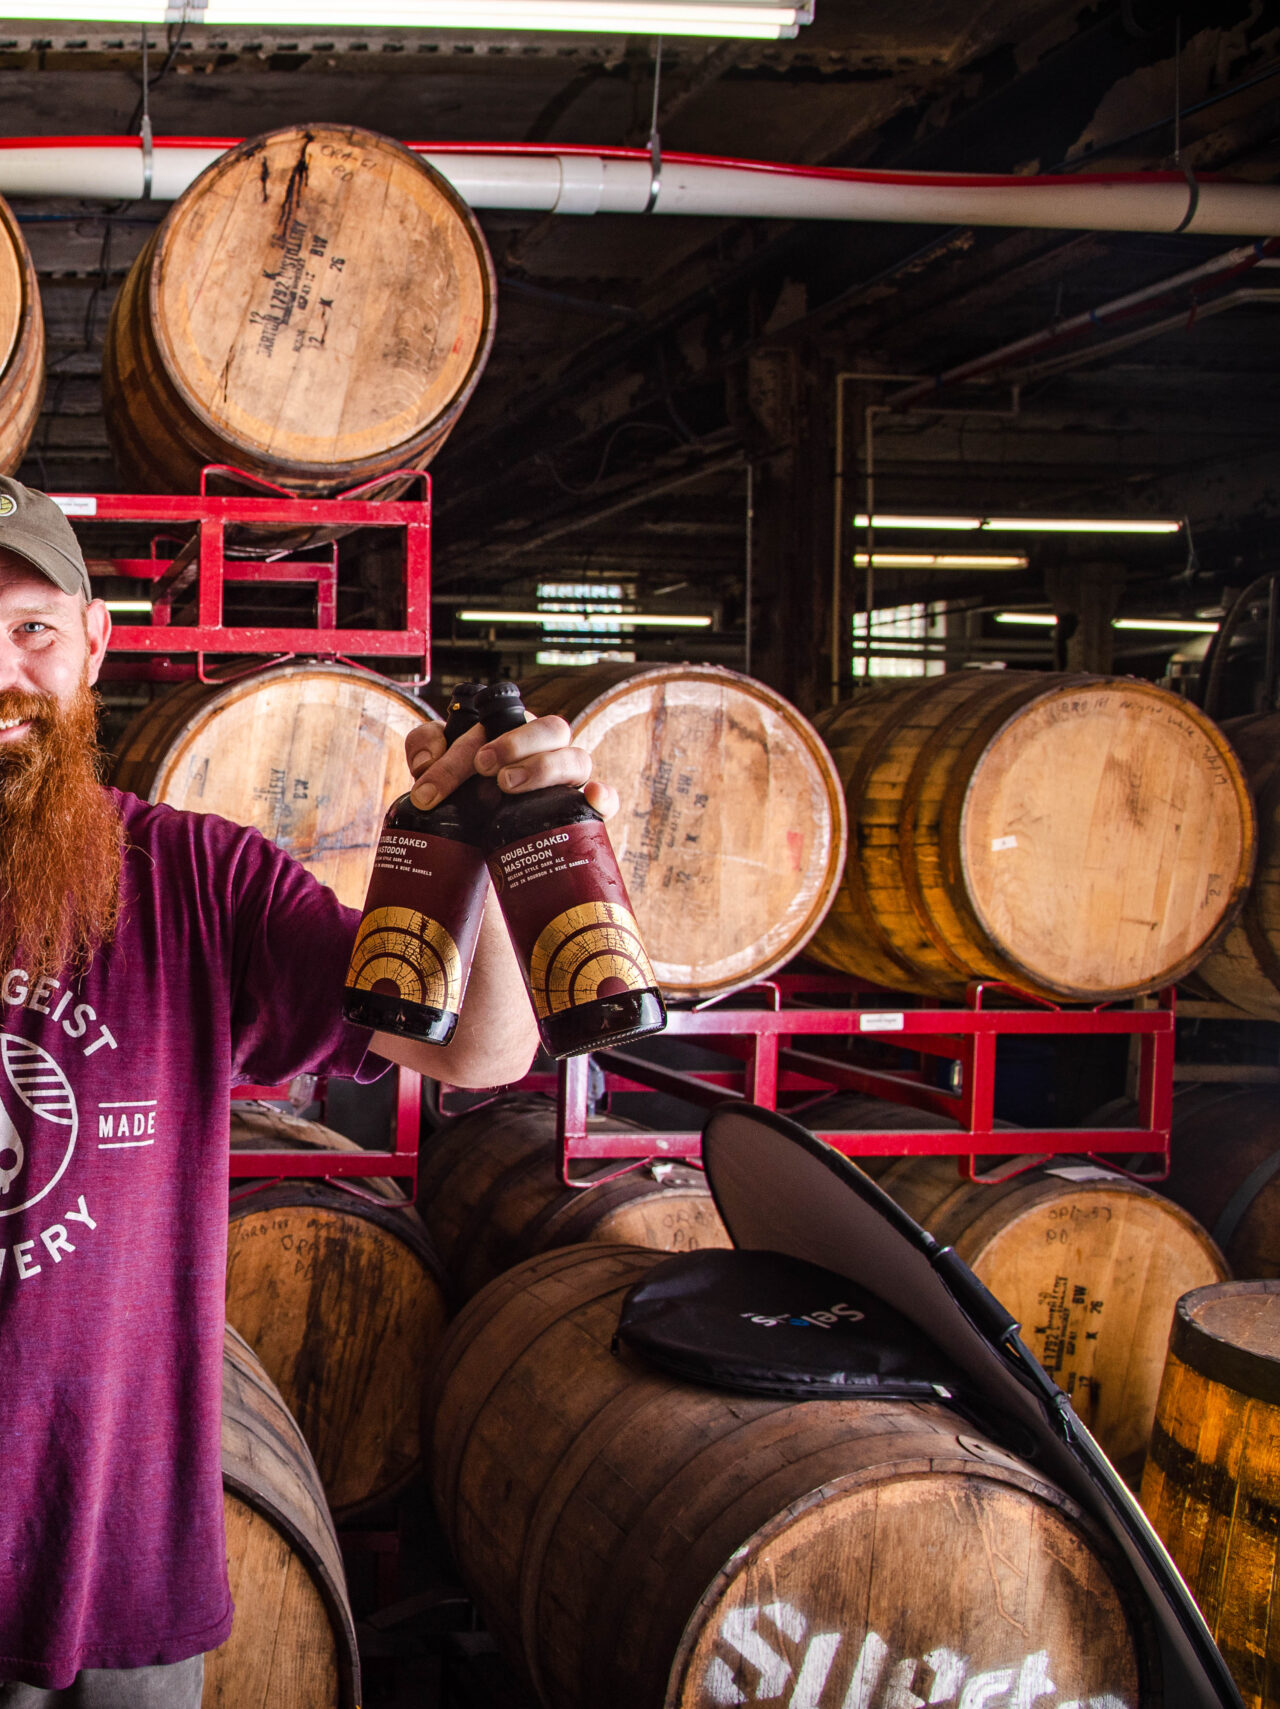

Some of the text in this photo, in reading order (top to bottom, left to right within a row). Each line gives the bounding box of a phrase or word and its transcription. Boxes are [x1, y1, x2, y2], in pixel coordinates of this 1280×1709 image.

[309, 234, 328, 257] BW
[319, 297, 334, 308] K
[330, 256, 346, 272] 26
[249, 311, 265, 325] 12
[263, 269, 280, 280] K
[270, 281, 290, 310] 1792
[377, 846, 407, 855] ASTODON
[380, 835, 428, 848] OUBLE OAKED
[501, 833, 570, 864] DOUBLE OAKED
[504, 849, 553, 874] MASTODON
[525, 865, 539, 874] STYLE
[528, 871, 547, 881] BOURBON
[98, 1110, 157, 1138] MADE
[1072, 1285, 1087, 1304] BW
[1090, 1300, 1103, 1314] 26
[1085, 1331, 1098, 1340] K
